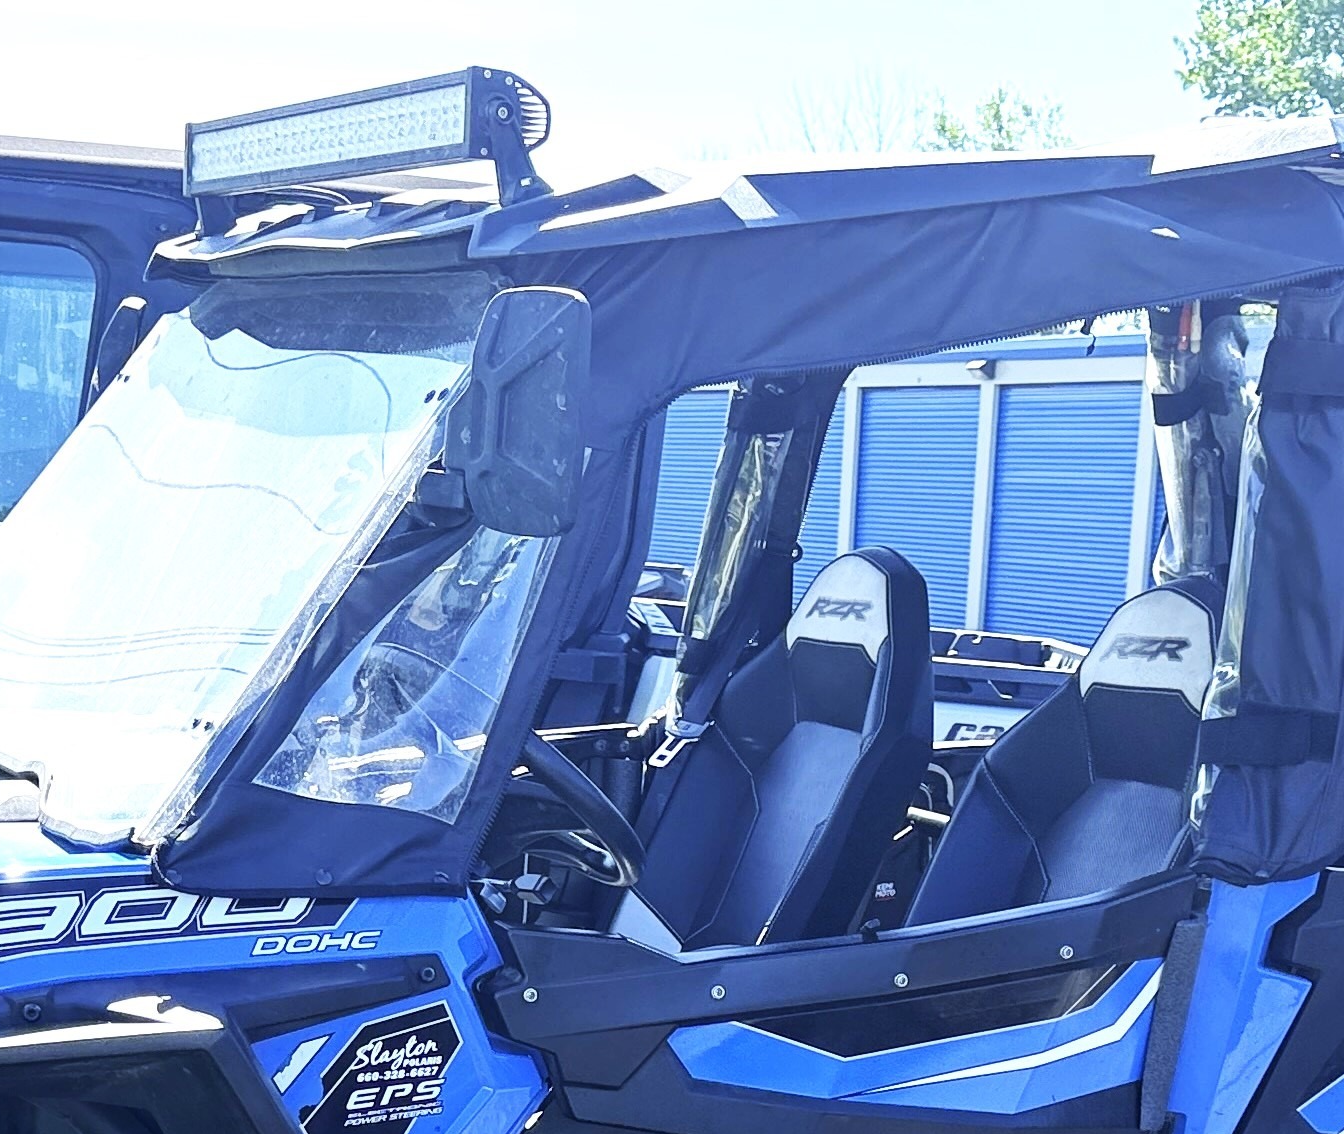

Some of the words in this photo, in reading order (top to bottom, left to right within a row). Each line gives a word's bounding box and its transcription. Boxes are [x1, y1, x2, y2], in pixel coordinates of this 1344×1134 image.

[805, 596, 875, 622] RZR
[1099, 633, 1192, 662] RZR
[250, 930, 383, 957] DOHC
[351, 1035, 438, 1070] Slayton
[403, 1056, 443, 1067] POLARIS
[346, 1079, 445, 1110] EPS
[343, 1114, 388, 1127] POWER
[388, 1106, 443, 1121] STEERING
